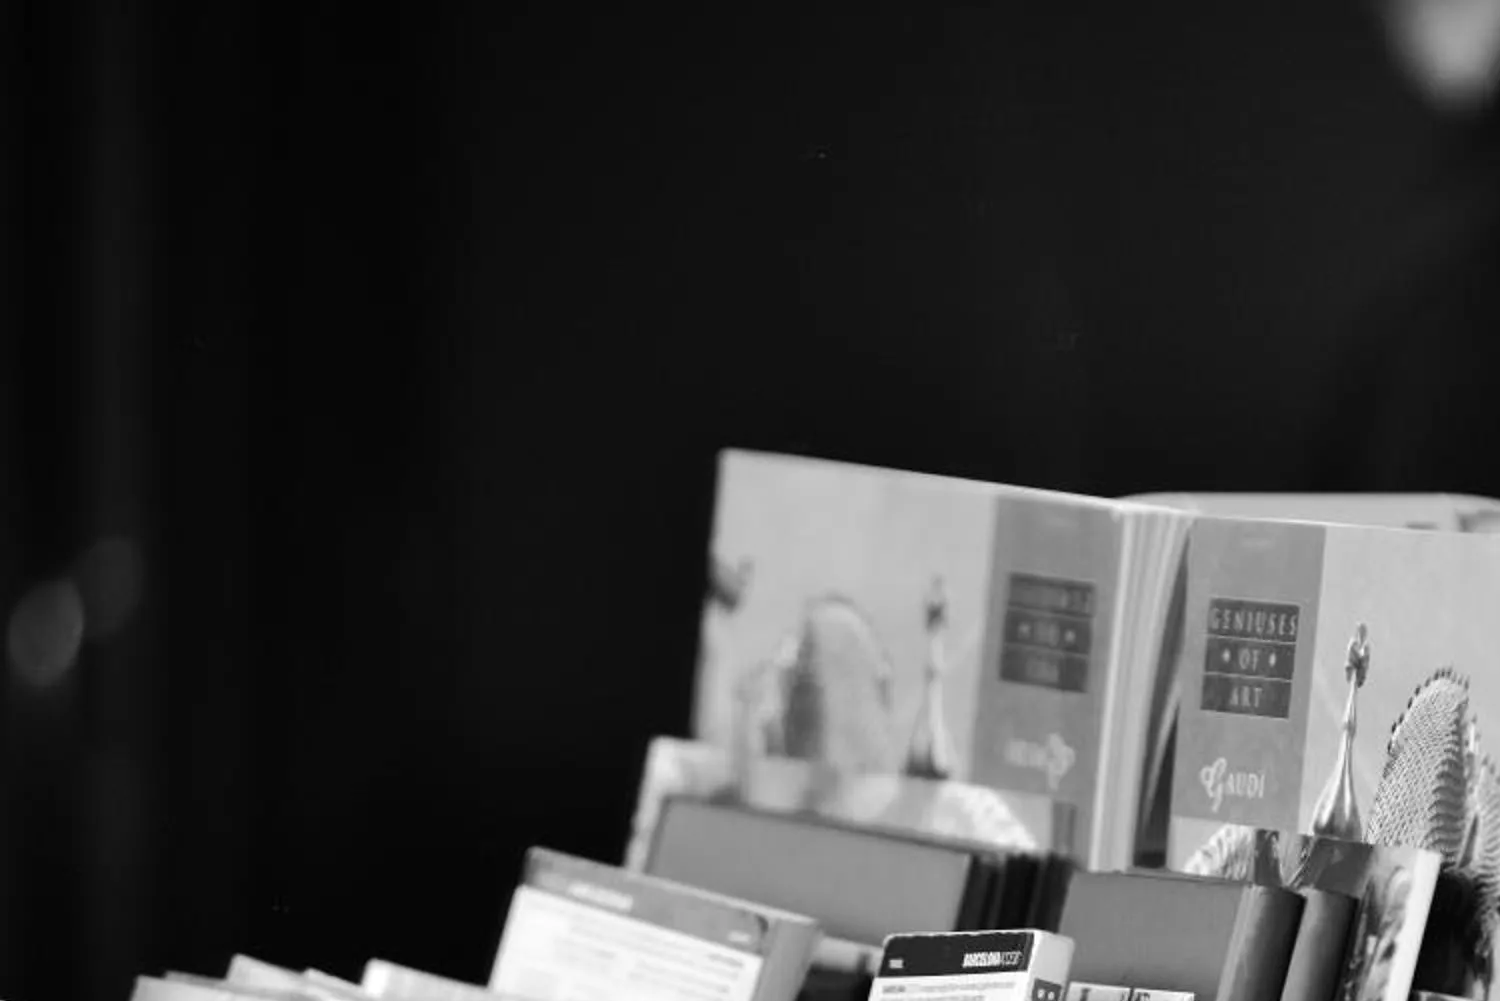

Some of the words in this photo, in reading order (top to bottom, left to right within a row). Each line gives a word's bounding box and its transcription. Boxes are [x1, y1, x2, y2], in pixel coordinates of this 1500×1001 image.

[1210, 607, 1297, 635] GENIUSES
[1238, 648, 1260, 671] OF
[1230, 685, 1263, 708] ART
